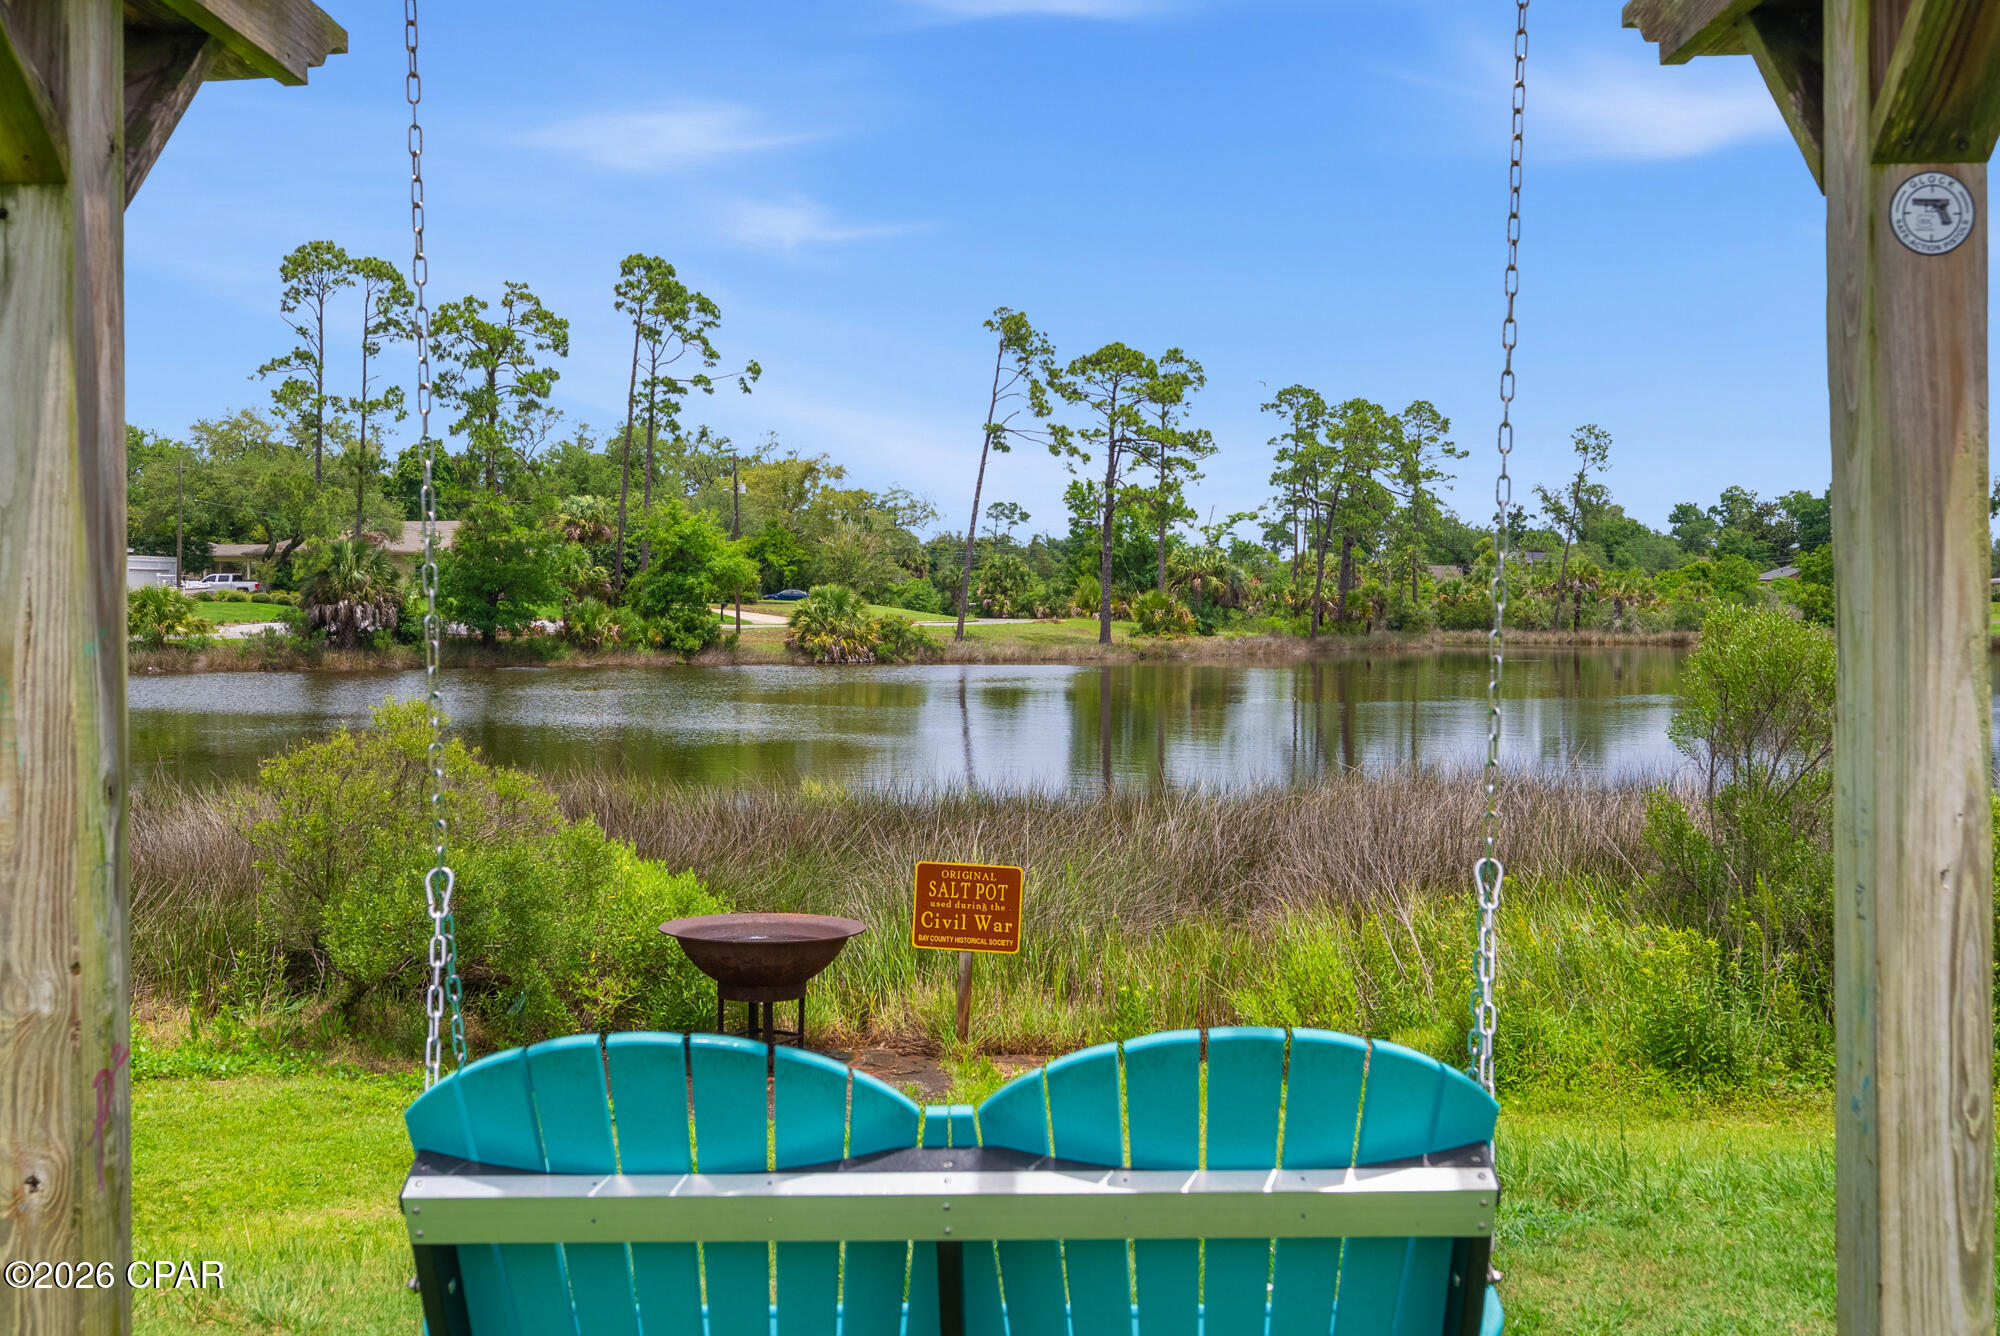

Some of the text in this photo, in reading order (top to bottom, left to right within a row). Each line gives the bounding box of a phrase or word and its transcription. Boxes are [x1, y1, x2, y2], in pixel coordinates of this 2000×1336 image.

[1909, 175, 1956, 188] GLOCK
[942, 870, 997, 881] ORIGINAL
[929, 880, 1008, 901] SALT POT
[930, 900, 1005, 911] used during the
[921, 911, 1012, 933] Civil War
[930, 935, 954, 943] COUNTY
[955, 936, 987, 945] HISTORICAL
